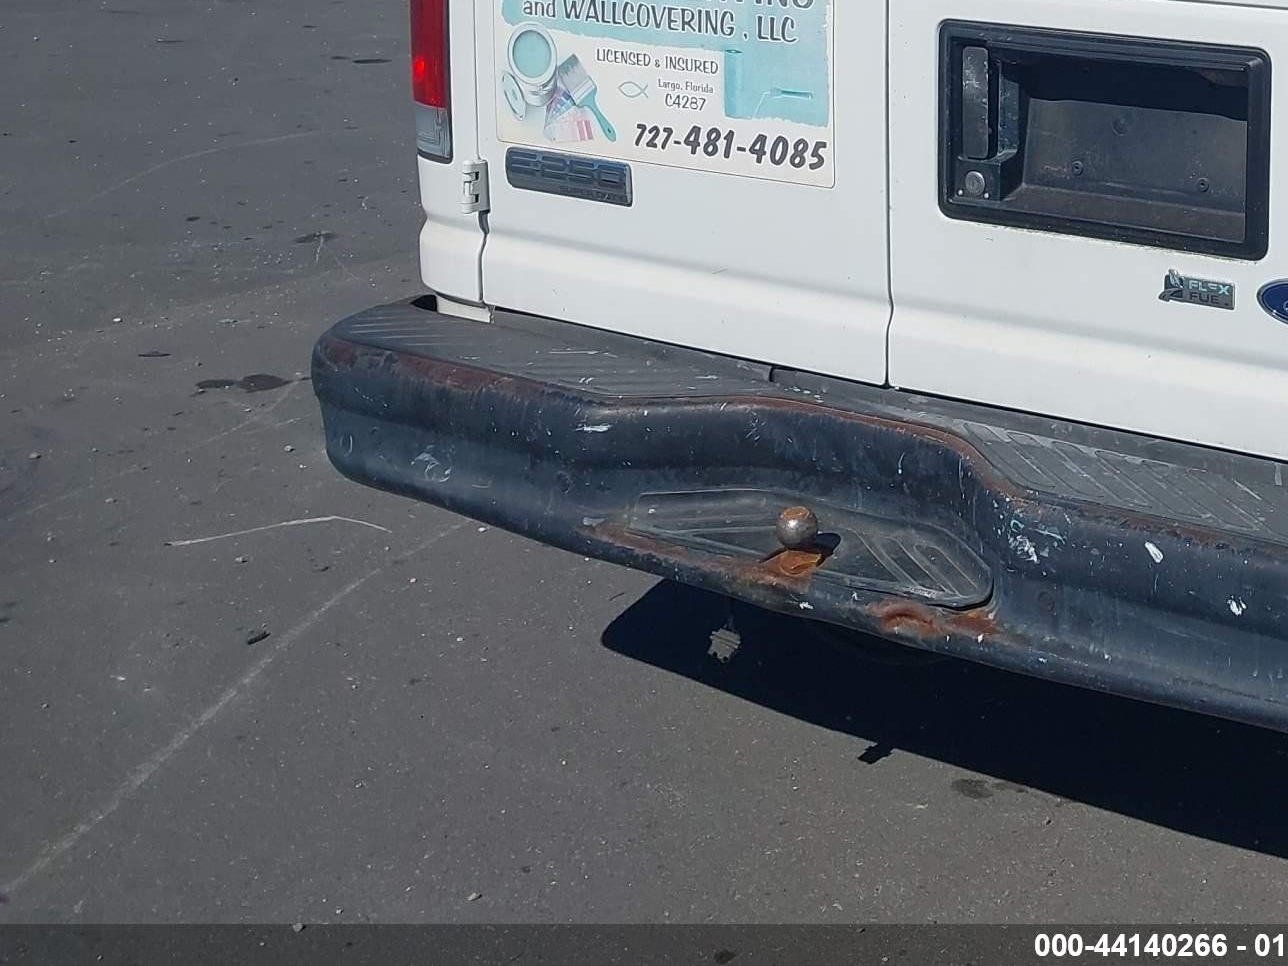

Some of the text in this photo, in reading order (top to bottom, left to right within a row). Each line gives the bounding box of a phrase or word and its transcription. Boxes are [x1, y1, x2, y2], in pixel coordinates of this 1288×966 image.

[756, 15, 798, 43] LLC
[596, 48, 651, 68] LICENSED
[664, 55, 719, 75] INSURED
[684, 80, 714, 95] Florida
[664, 93, 707, 112] C4287
[634, 123, 828, 171] 727-481-4085
[1190, 290, 1230, 307] FUE
